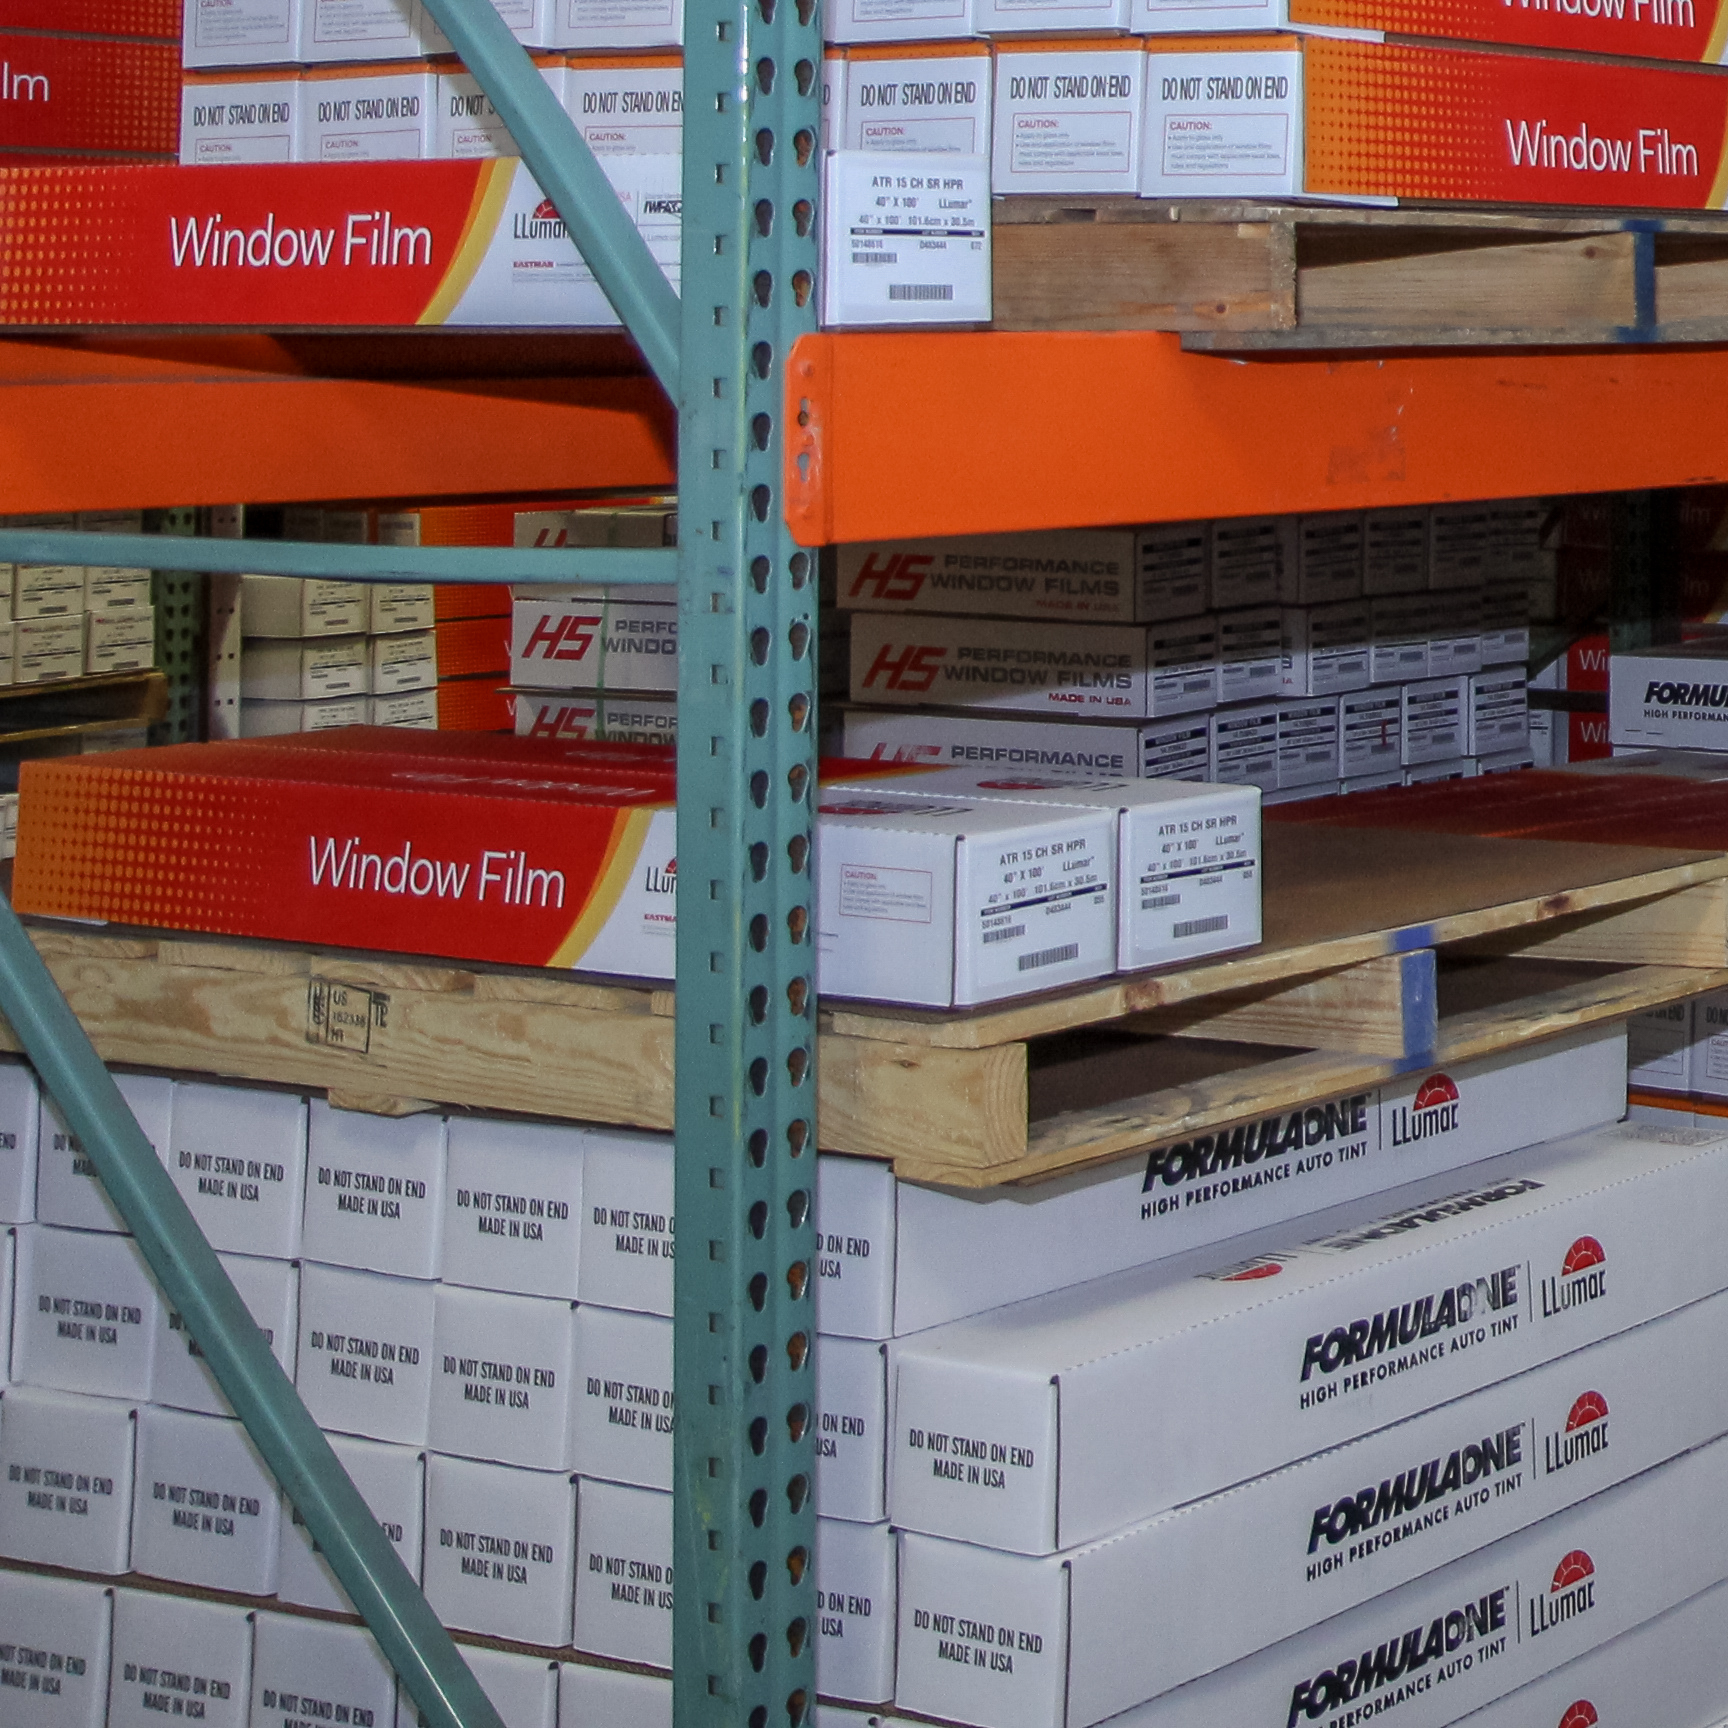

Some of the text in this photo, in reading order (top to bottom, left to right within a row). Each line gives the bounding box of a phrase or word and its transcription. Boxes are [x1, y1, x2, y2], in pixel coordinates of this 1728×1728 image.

[1162, 76, 1288, 100] DO NOT STAND ON END
[1170, 121, 1213, 131] CAUTION:
[1506, 120, 1697, 175] Window Film
[871, 175, 964, 190] ATR 15 CH SR HPR
[171, 212, 431, 266] Window Film
[861, 643, 948, 692] HS
[943, 663, 1132, 690] WINDOW FILMS
[957, 646, 1132, 669] PERFORMANCE
[1048, 692, 1132, 707] MADE IN USA
[1644, 709, 1668, 719] HIGH
[311, 836, 564, 908] Window Film
[1392, 1102, 1459, 1147] LLumar
[1141, 1142, 1366, 1220] HIGH PERFORMANCE AUTO TINT
[1541, 1269, 1607, 1318] LLumar
[1301, 1315, 1518, 1410] HIGH PERFORMANCE AUTO TINT
[910, 1429, 1033, 1468] DO NOT STAND ON END
[1545, 1420, 1609, 1474] LLumar
[934, 1459, 1005, 1489] MADE IN USA
[1306, 1473, 1521, 1582] HIGH PERFORMANCE AUTO TINT
[914, 1609, 1042, 1653] DO NOT STAND ON END
[1530, 1580, 1595, 1638] LLumar
[939, 1640, 1012, 1674] MADE IN USA
[1328, 1637, 1505, 1728] PERFORMANCE AUTO TINT
